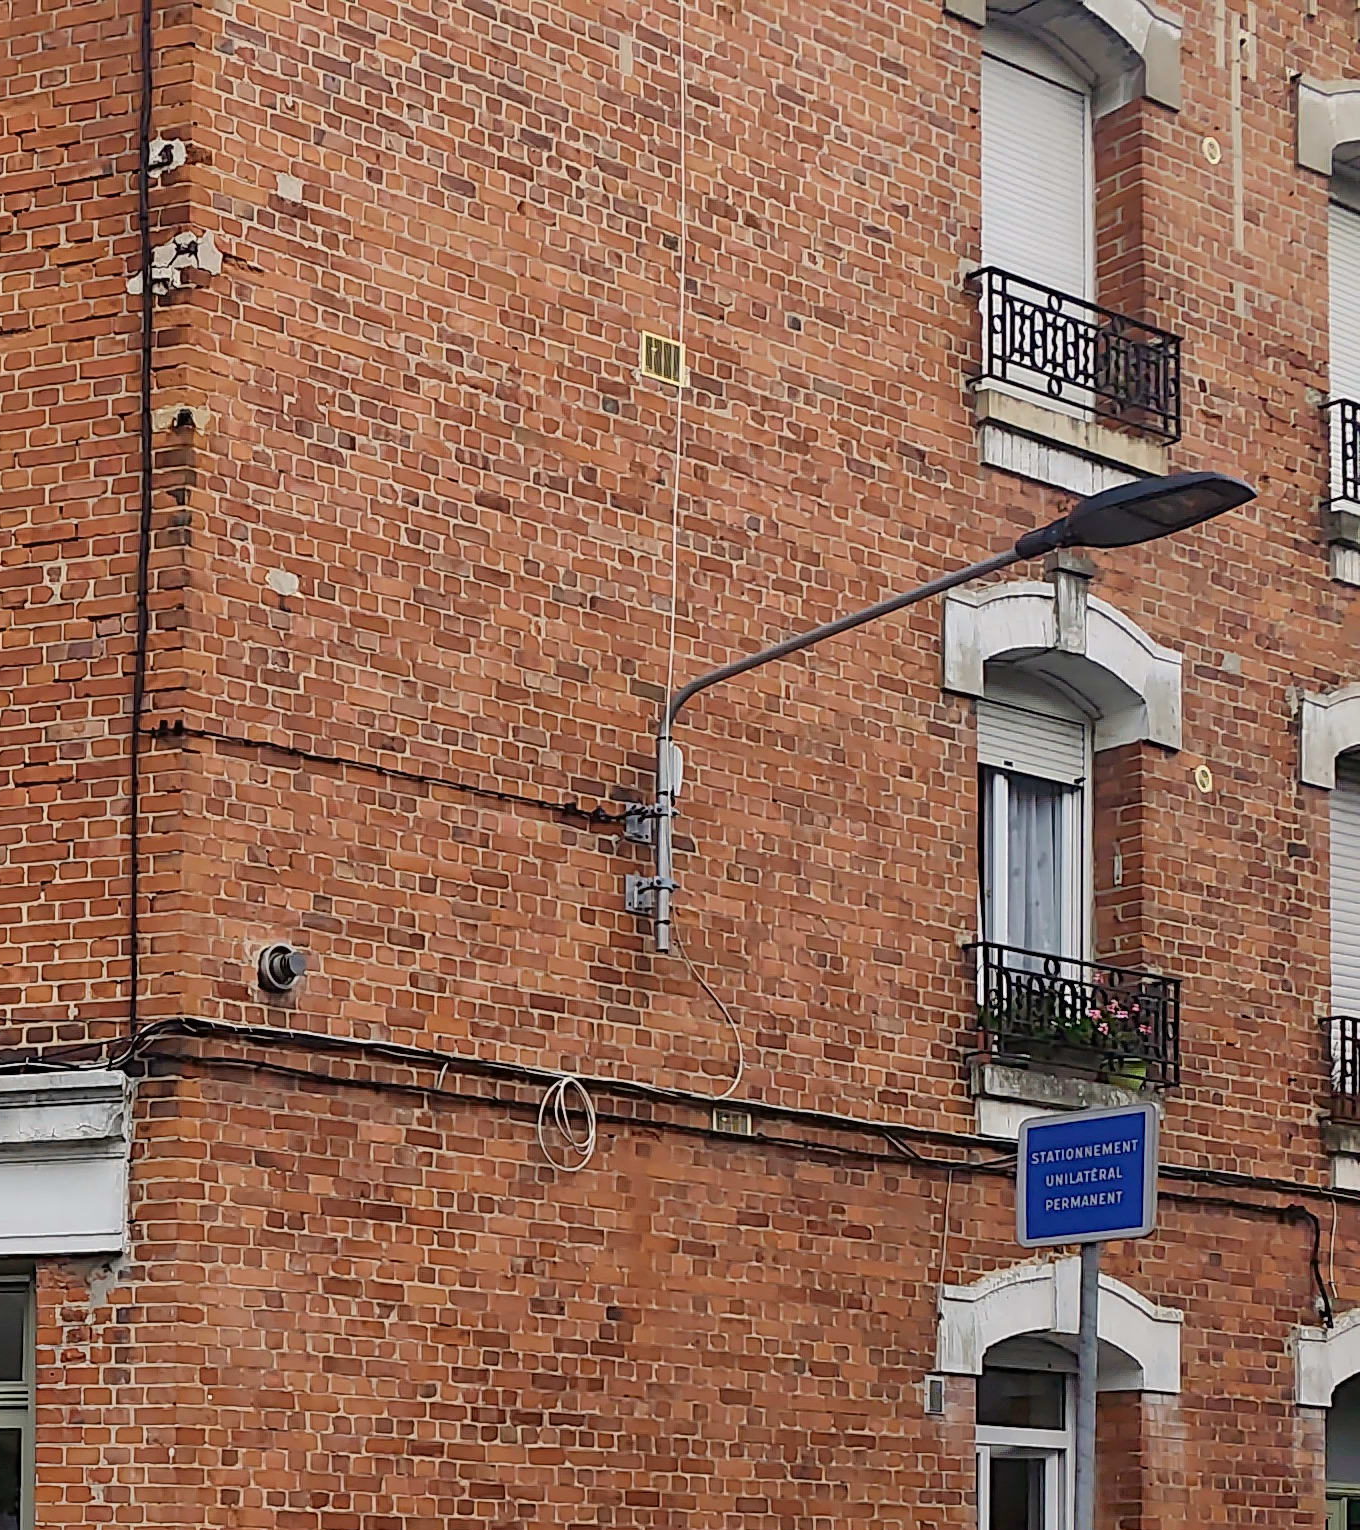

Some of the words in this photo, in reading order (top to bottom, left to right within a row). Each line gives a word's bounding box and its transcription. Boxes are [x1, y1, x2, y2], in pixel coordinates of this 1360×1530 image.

[1031, 1139, 1139, 1165] STATIONNEMENT
[1045, 1166, 1123, 1187] UNILATÉRAL
[1045, 1191, 1123, 1211] PERMANENT
